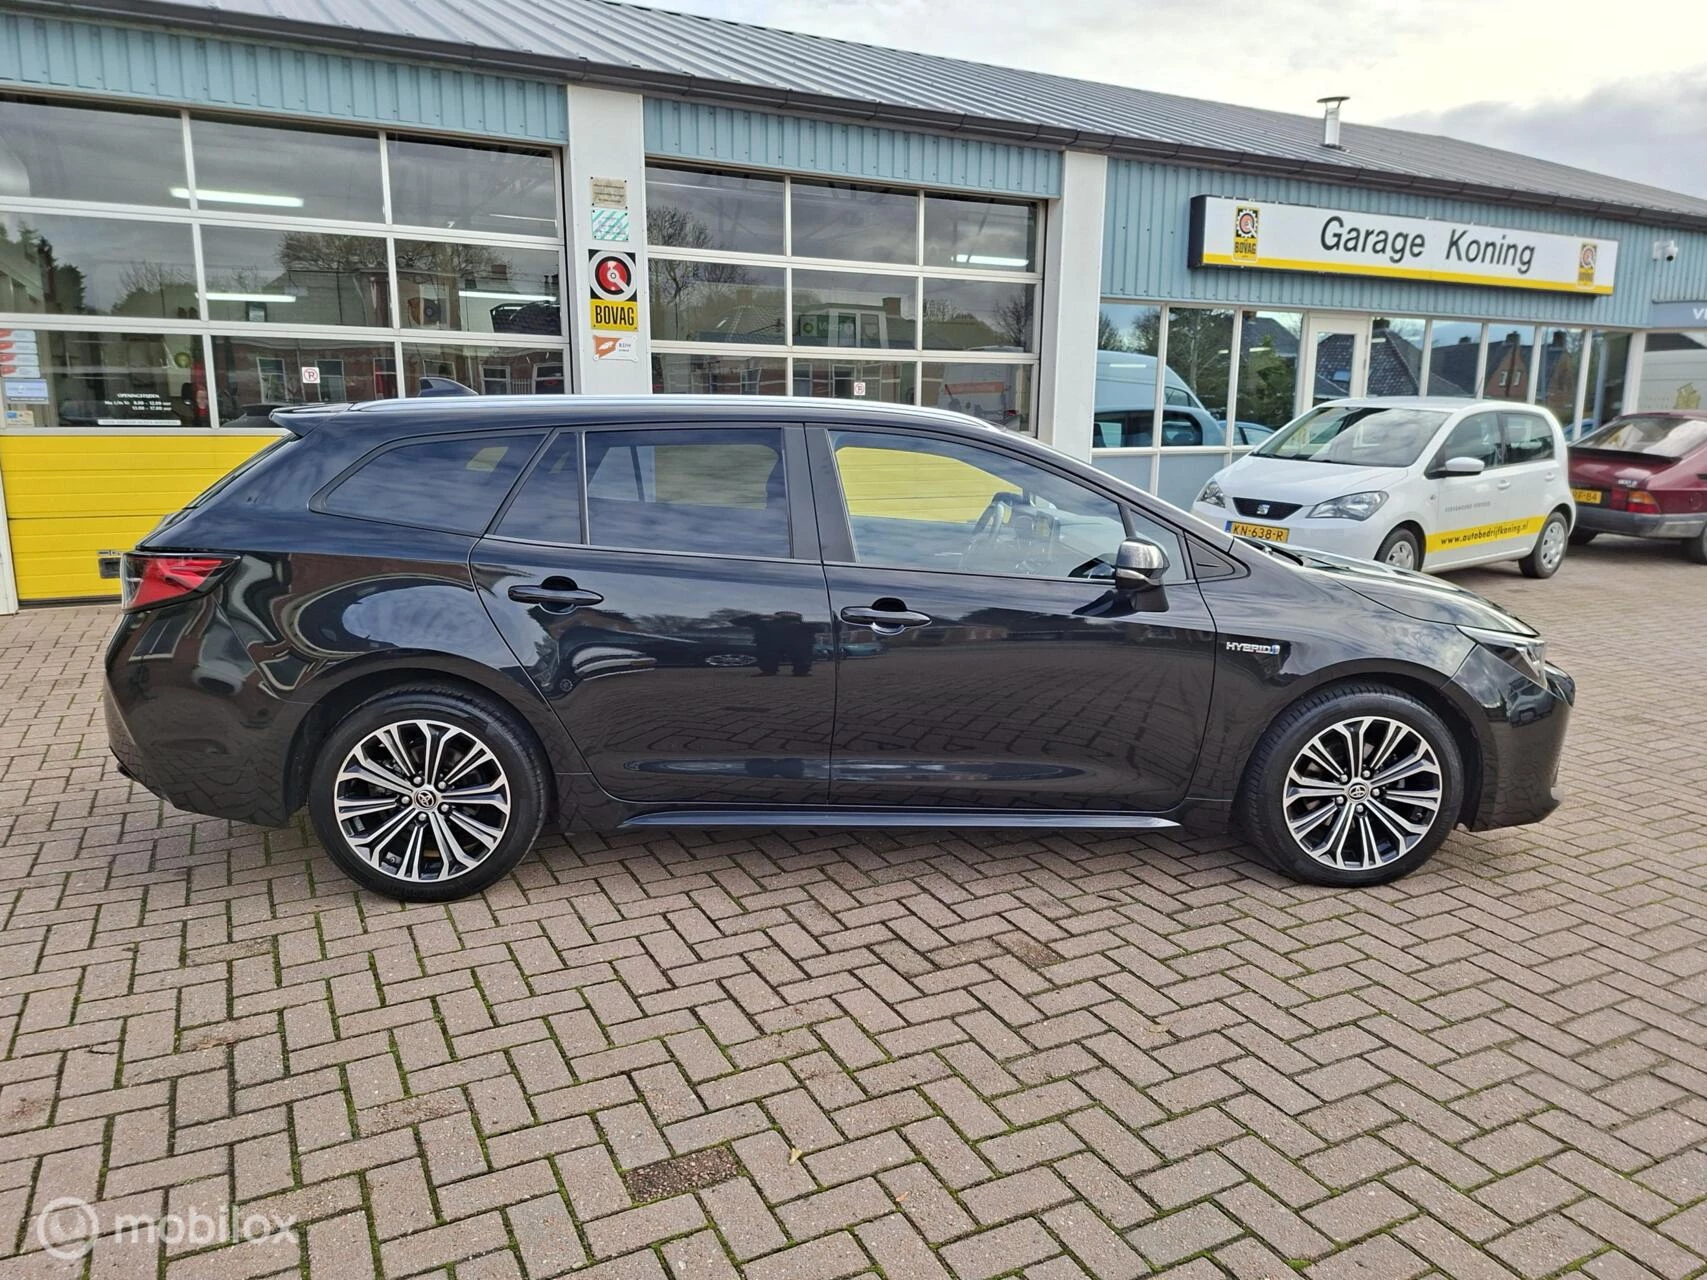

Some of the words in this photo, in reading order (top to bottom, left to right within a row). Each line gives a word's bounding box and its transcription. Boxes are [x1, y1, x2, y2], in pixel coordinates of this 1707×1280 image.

[1234, 241, 1256, 255] BOVAG
[1320, 215, 1426, 264] Garage
[1446, 228, 1536, 275] Koning
[594, 304, 635, 326] BOVAG
[1233, 523, 1284, 541] KN-638-R
[1441, 519, 1529, 545] www.autobedrijfkoning.nl
[1226, 641, 1272, 654] HYBRID
